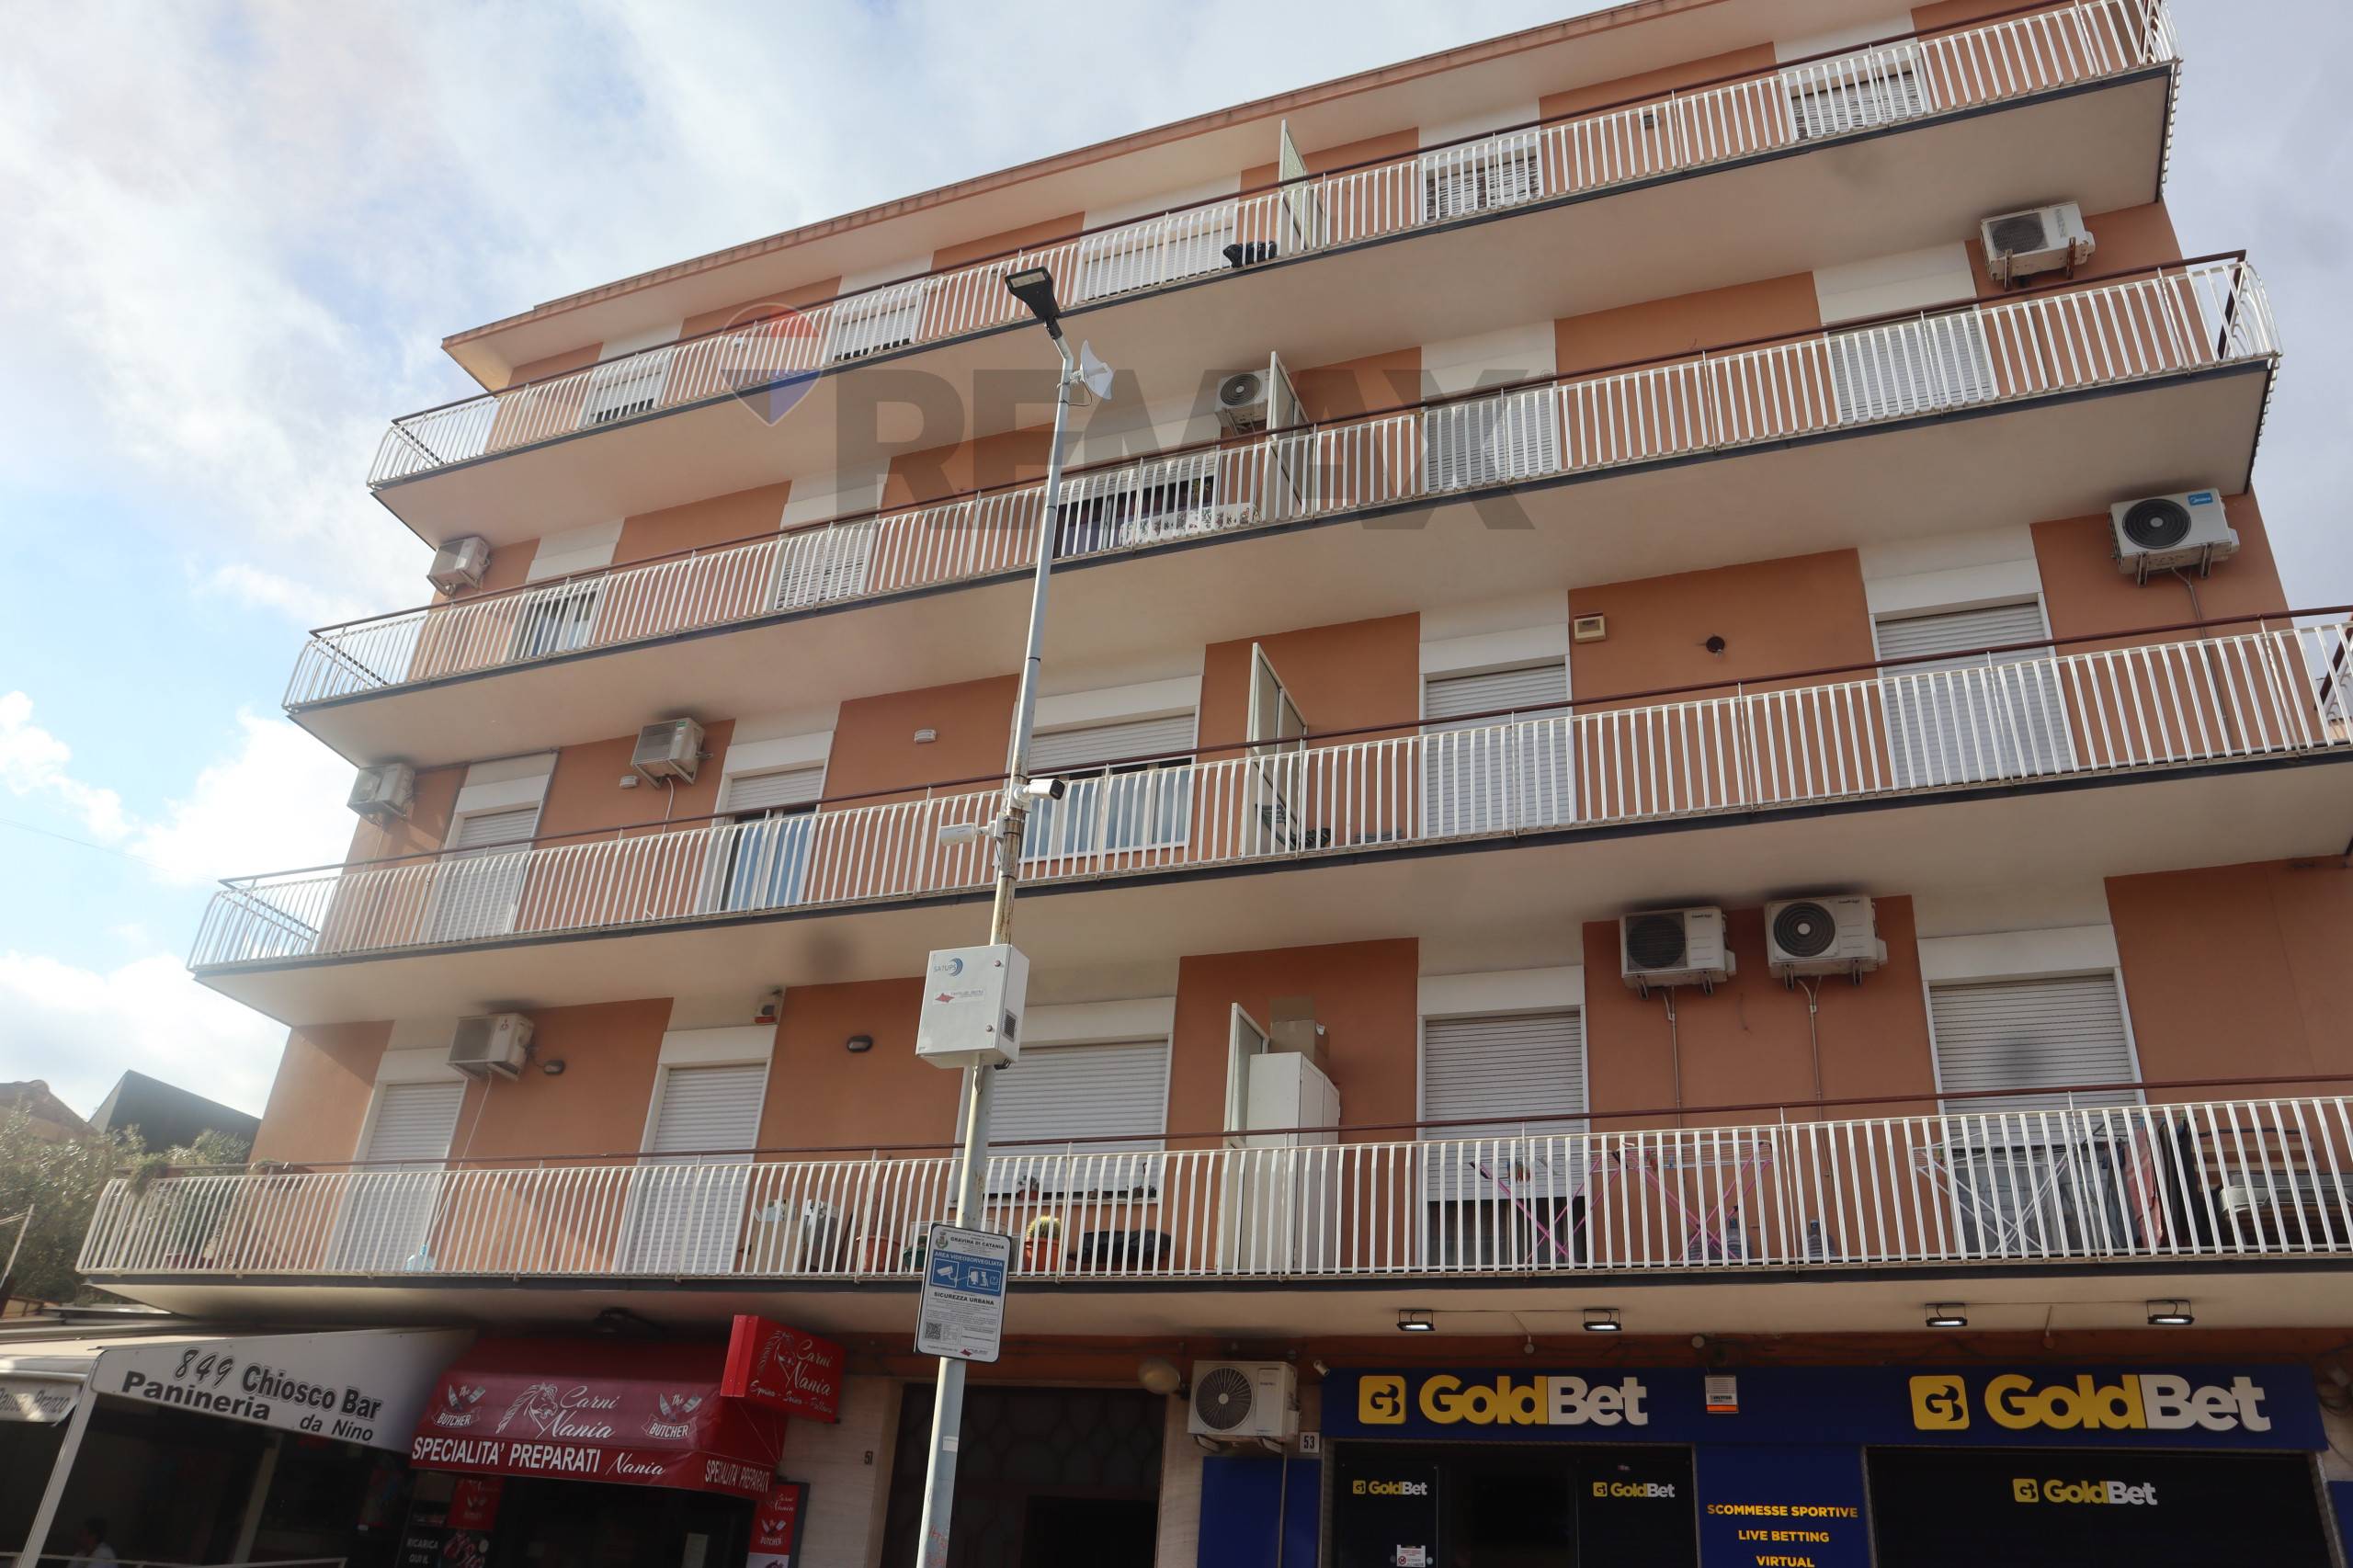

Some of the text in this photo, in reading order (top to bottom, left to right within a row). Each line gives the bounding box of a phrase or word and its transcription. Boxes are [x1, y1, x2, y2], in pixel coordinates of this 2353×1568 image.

[949, 1253, 1003, 1267] VIDEOSORVEGLIATA
[934, 1291, 968, 1301] SICUREZZA
[969, 1297, 995, 1305] URBANA
[797, 1339, 833, 1368] Carni
[175, 1347, 233, 1389] 849
[791, 1360, 831, 1395] Nania
[121, 1370, 271, 1421] Panineria
[242, 1363, 383, 1420] Chiosco Bar
[560, 1385, 620, 1410] Carni
[1418, 1374, 1649, 1426] GoldBet
[1984, 1374, 2272, 1432] GoldBet
[300, 1414, 373, 1442] da Nino
[437, 1411, 472, 1426] BUTCHER
[550, 1410, 616, 1439] Nania
[649, 1422, 689, 1438] BUTCHER
[1303, 1435, 1315, 1449] 53
[412, 1437, 666, 1475] SPECIALITA' PREPARATI Nania
[1368, 1481, 1428, 1496] GoldBet
[1610, 1482, 1676, 1498] GoldBet
[2043, 1480, 2158, 1506] GoldBet
[1707, 1504, 1859, 1517] SCOMMESSE SPORTIVE
[1738, 1529, 1830, 1543] LIVE BETTING
[1756, 1555, 1815, 1568] VIRTUAL
